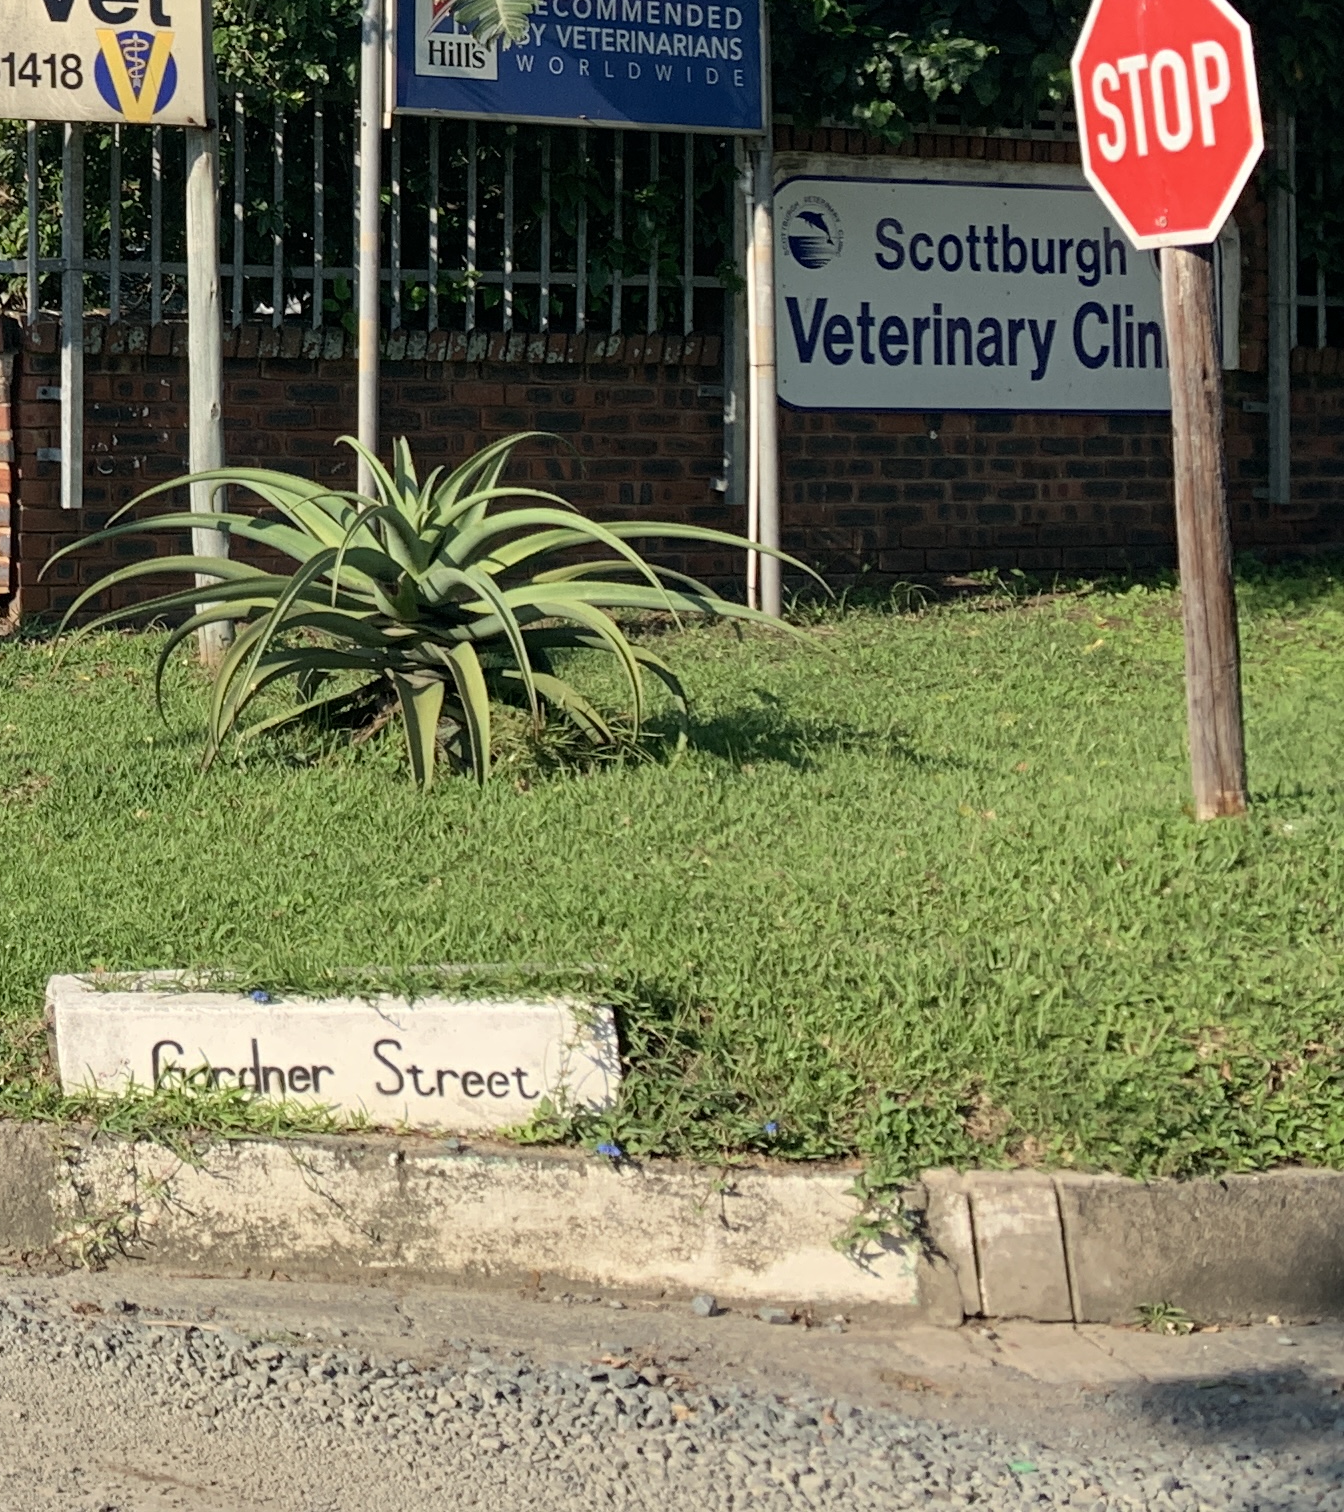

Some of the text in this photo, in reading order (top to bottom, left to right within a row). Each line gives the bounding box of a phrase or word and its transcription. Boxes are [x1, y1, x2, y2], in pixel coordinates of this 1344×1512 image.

[427, 39, 486, 69] Hill's
[515, 54, 744, 88] WORLDWIDE
[555, 24, 743, 61] VETERINARIANS
[1090, 39, 1231, 163] STOP
[874, 217, 1128, 287] Scottburgh
[785, 296, 1170, 381] Veterinary Clin
[373, 1038, 541, 1101] Street
